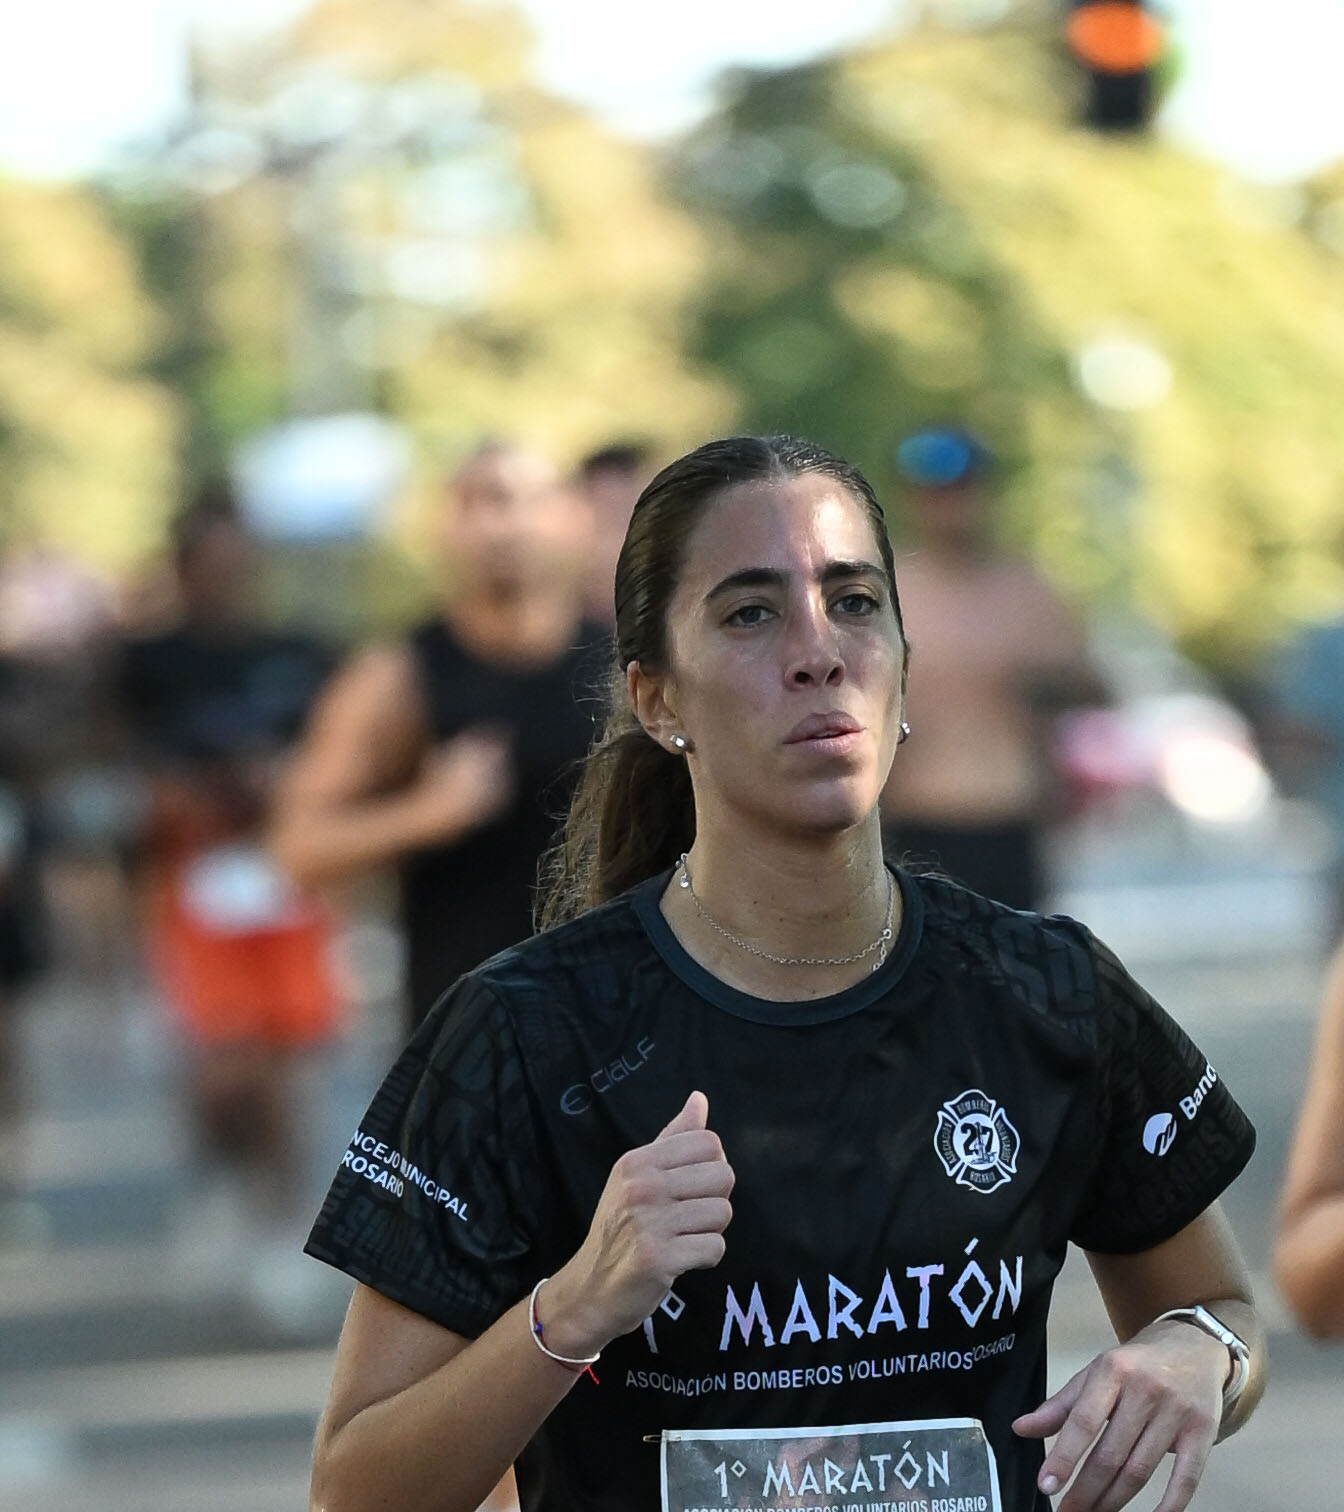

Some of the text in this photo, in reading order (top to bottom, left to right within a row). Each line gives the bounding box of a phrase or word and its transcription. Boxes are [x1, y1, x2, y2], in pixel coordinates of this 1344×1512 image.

[960, 1123, 993, 1157] 27
[342, 1150, 405, 1198] ROSARIO
[719, 1237, 1023, 1351] MARATÓN
[626, 1333, 1016, 1397] ASOCIACIÓN BOMBEROS VOLUNTARIOS OSARIO
[762, 1440, 950, 1498] MARATÓN
